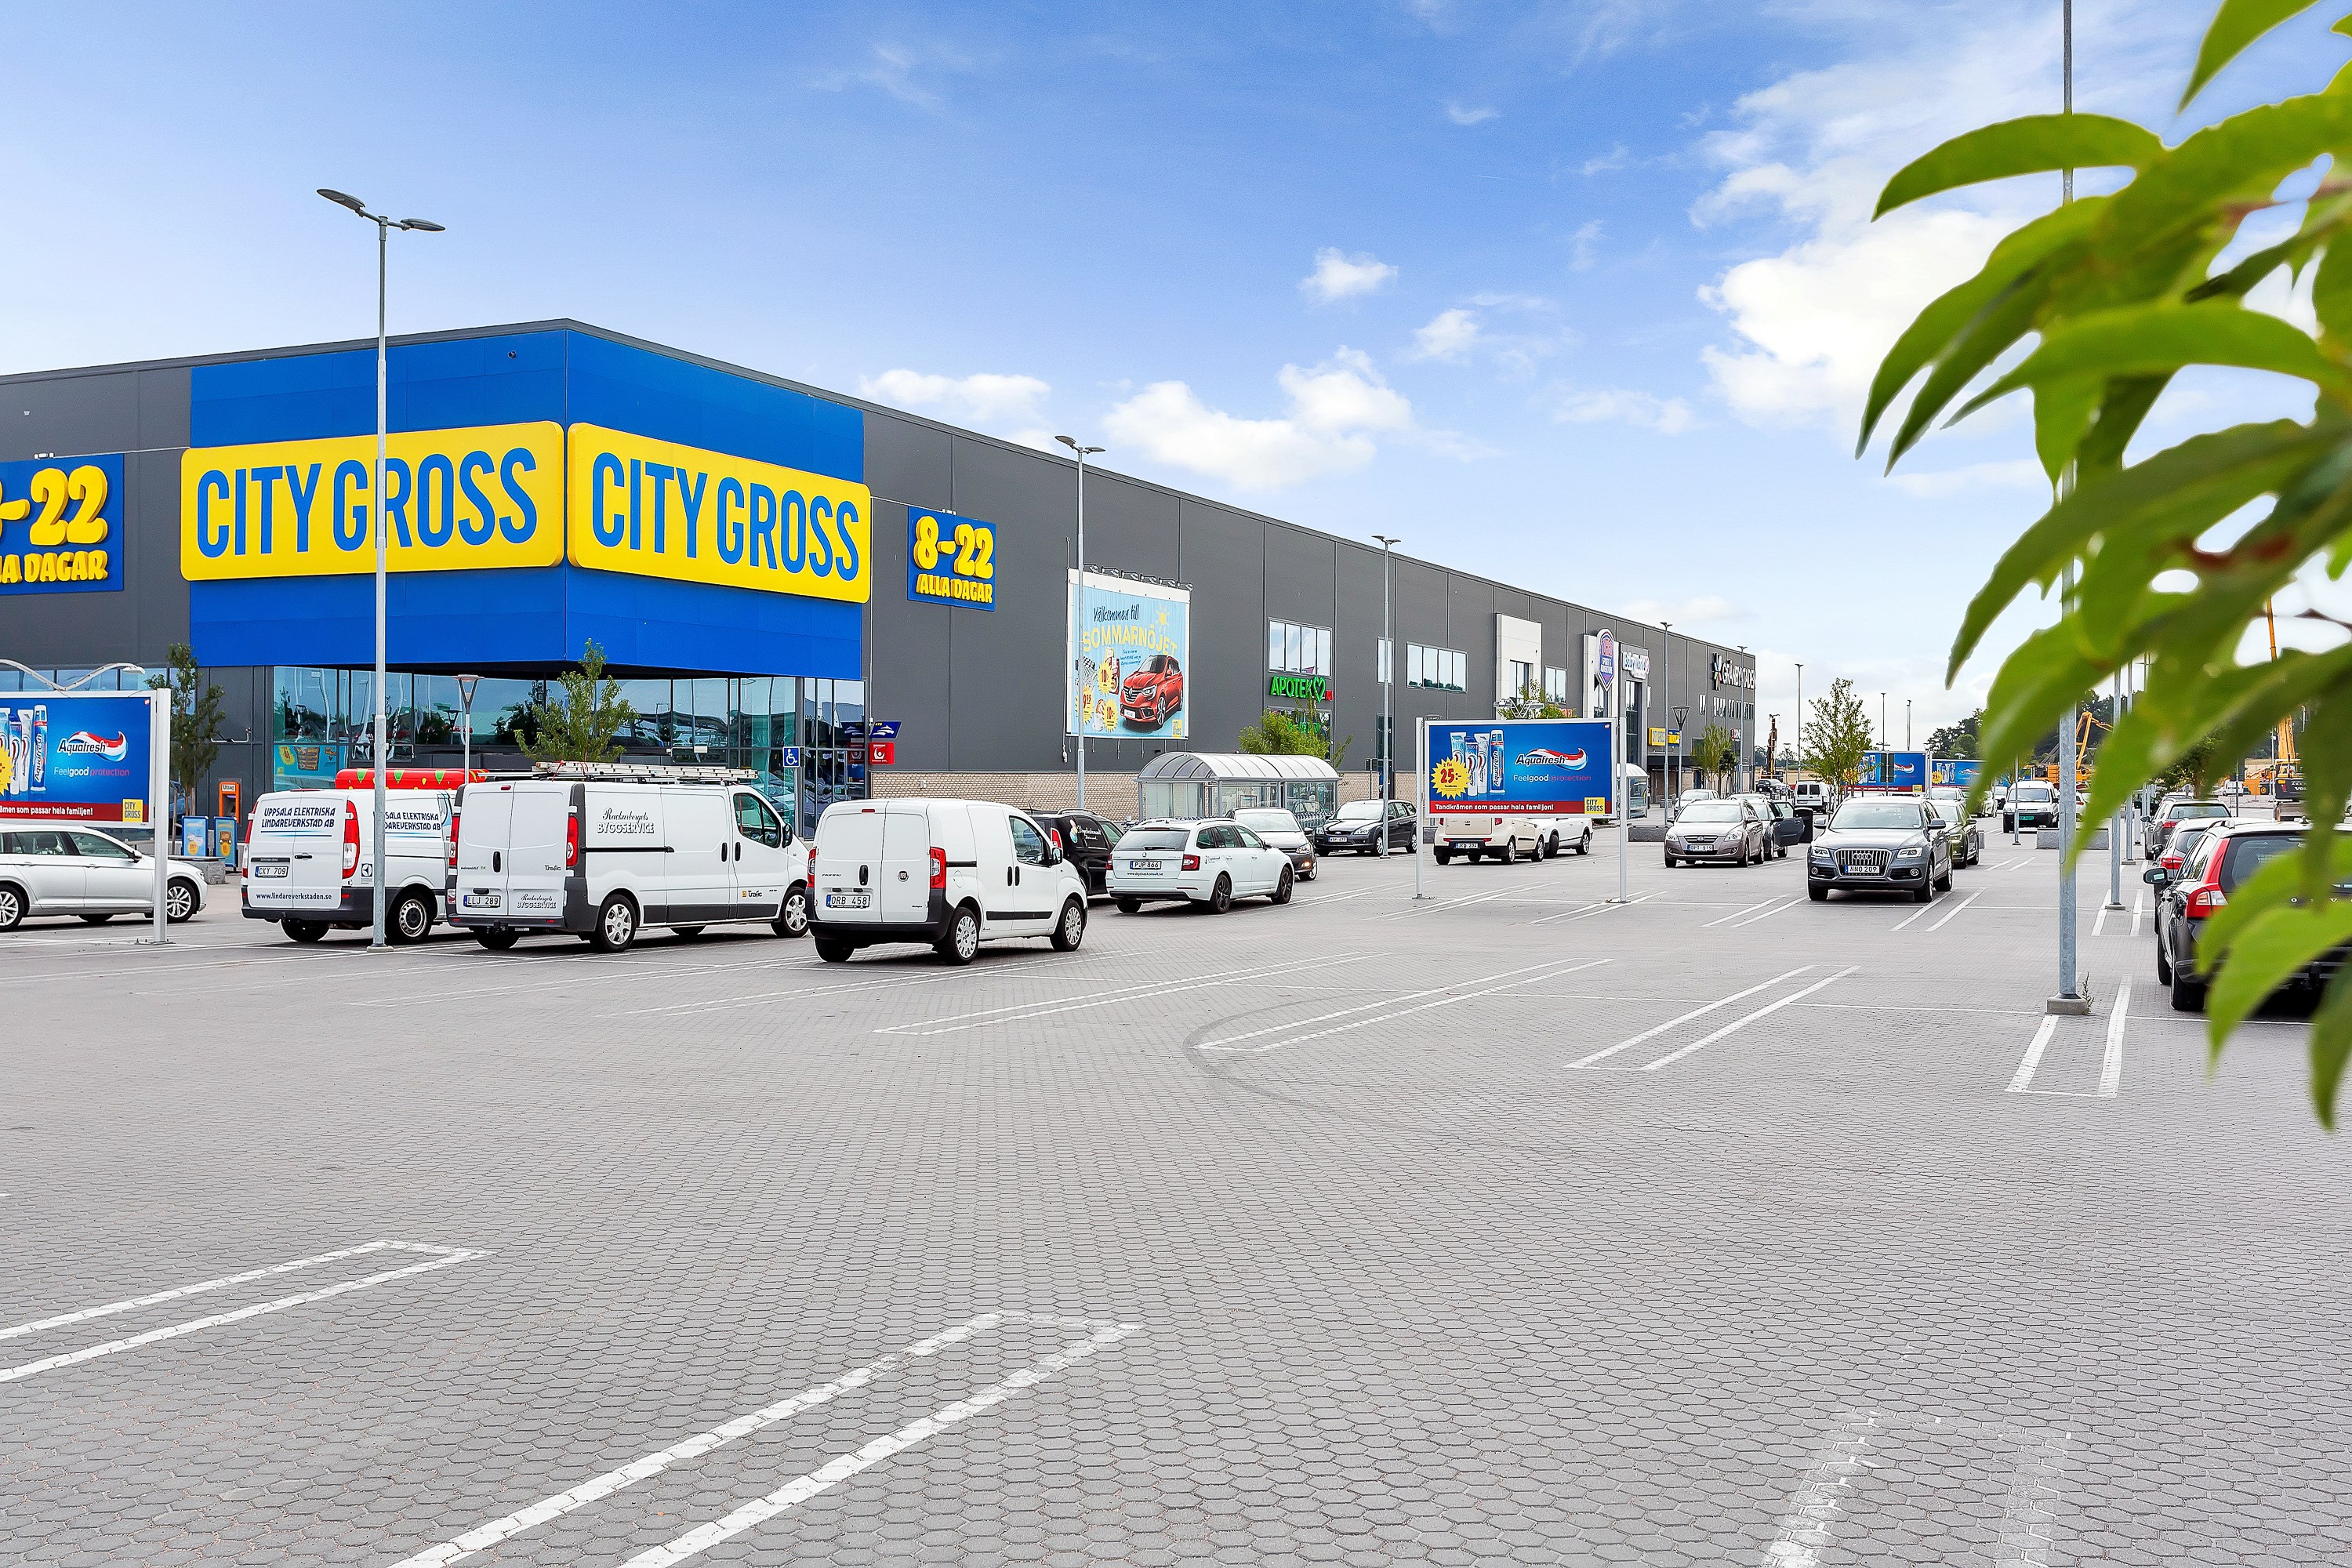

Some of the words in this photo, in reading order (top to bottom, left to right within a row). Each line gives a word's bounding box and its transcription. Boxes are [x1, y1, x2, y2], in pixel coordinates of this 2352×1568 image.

[0, 465, 108, 546] -22
[198, 463, 321, 558] CITY
[333, 447, 537, 552] GROSS
[593, 452, 707, 558] CITY
[717, 477, 859, 581] GROSS
[913, 515, 994, 579] 8-22
[24, 550, 108, 583] DAGAR
[916, 573, 951, 598] ALLA
[953, 579, 993, 604] DAGAR
[1094, 605, 1129, 622] Välkommen
[1131, 604, 1140, 620] till
[1082, 623, 1178, 657] SOMMARNÖJET
[1270, 676, 1313, 699] APOTEK
[58, 739, 106, 755] Aquafresh
[1515, 754, 1566, 767] Aquafresh
[53, 767, 89, 778] Feelgood
[1440, 768, 1462, 783] 25:-
[1513, 774, 1549, 782] Feelgood
[67, 807, 93, 816] familjen!
[124, 801, 136, 810] CITY
[263, 808, 292, 817] UPPSALA
[293, 807, 336, 817] ELEKTRISKA
[124, 810, 141, 818] GROSS
[403, 812, 439, 821] ELEKTRISKA
[261, 818, 323, 828] LINDAREVERKSTAD
[324, 818, 335, 828] AB
[597, 822, 655, 834] BYGGSERVICE
[467, 895, 481, 905] LLJ
[485, 896, 499, 905] 289
[851, 896, 868, 905] 458
